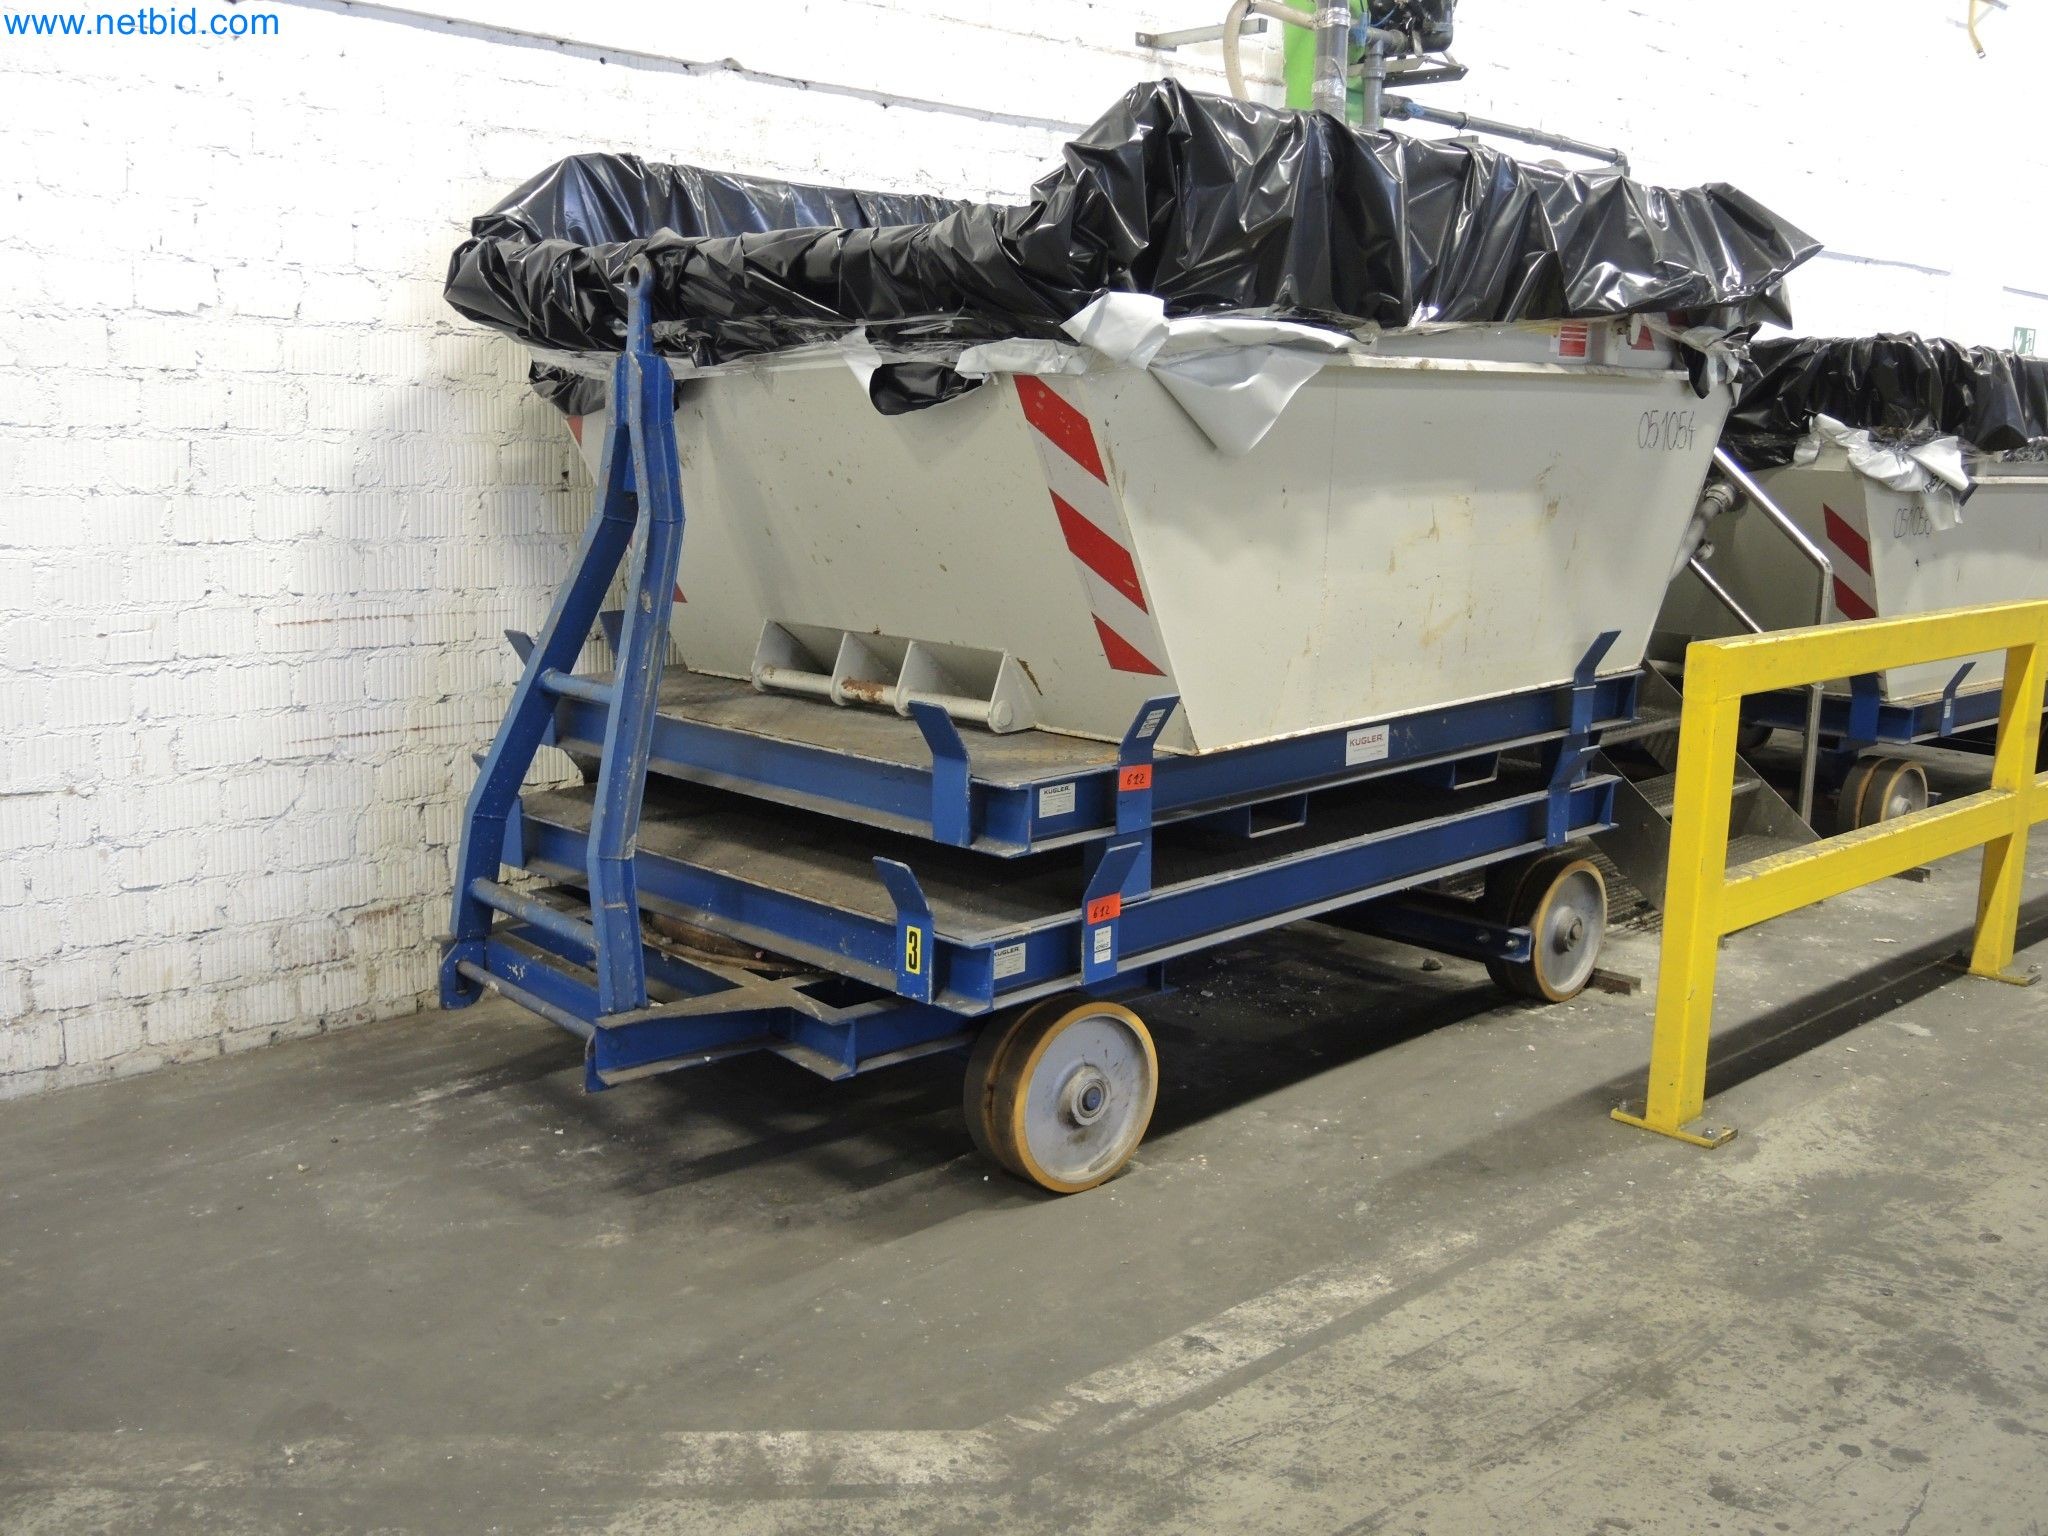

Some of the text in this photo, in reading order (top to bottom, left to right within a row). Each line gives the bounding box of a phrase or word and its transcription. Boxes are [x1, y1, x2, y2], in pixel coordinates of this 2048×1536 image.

[1638, 409, 1696, 451] 051054
[1350, 734, 1383, 747] KUGLER
[1127, 773, 1144, 785] 612
[1093, 905, 1110, 918] 612
[908, 930, 918, 970] 3
